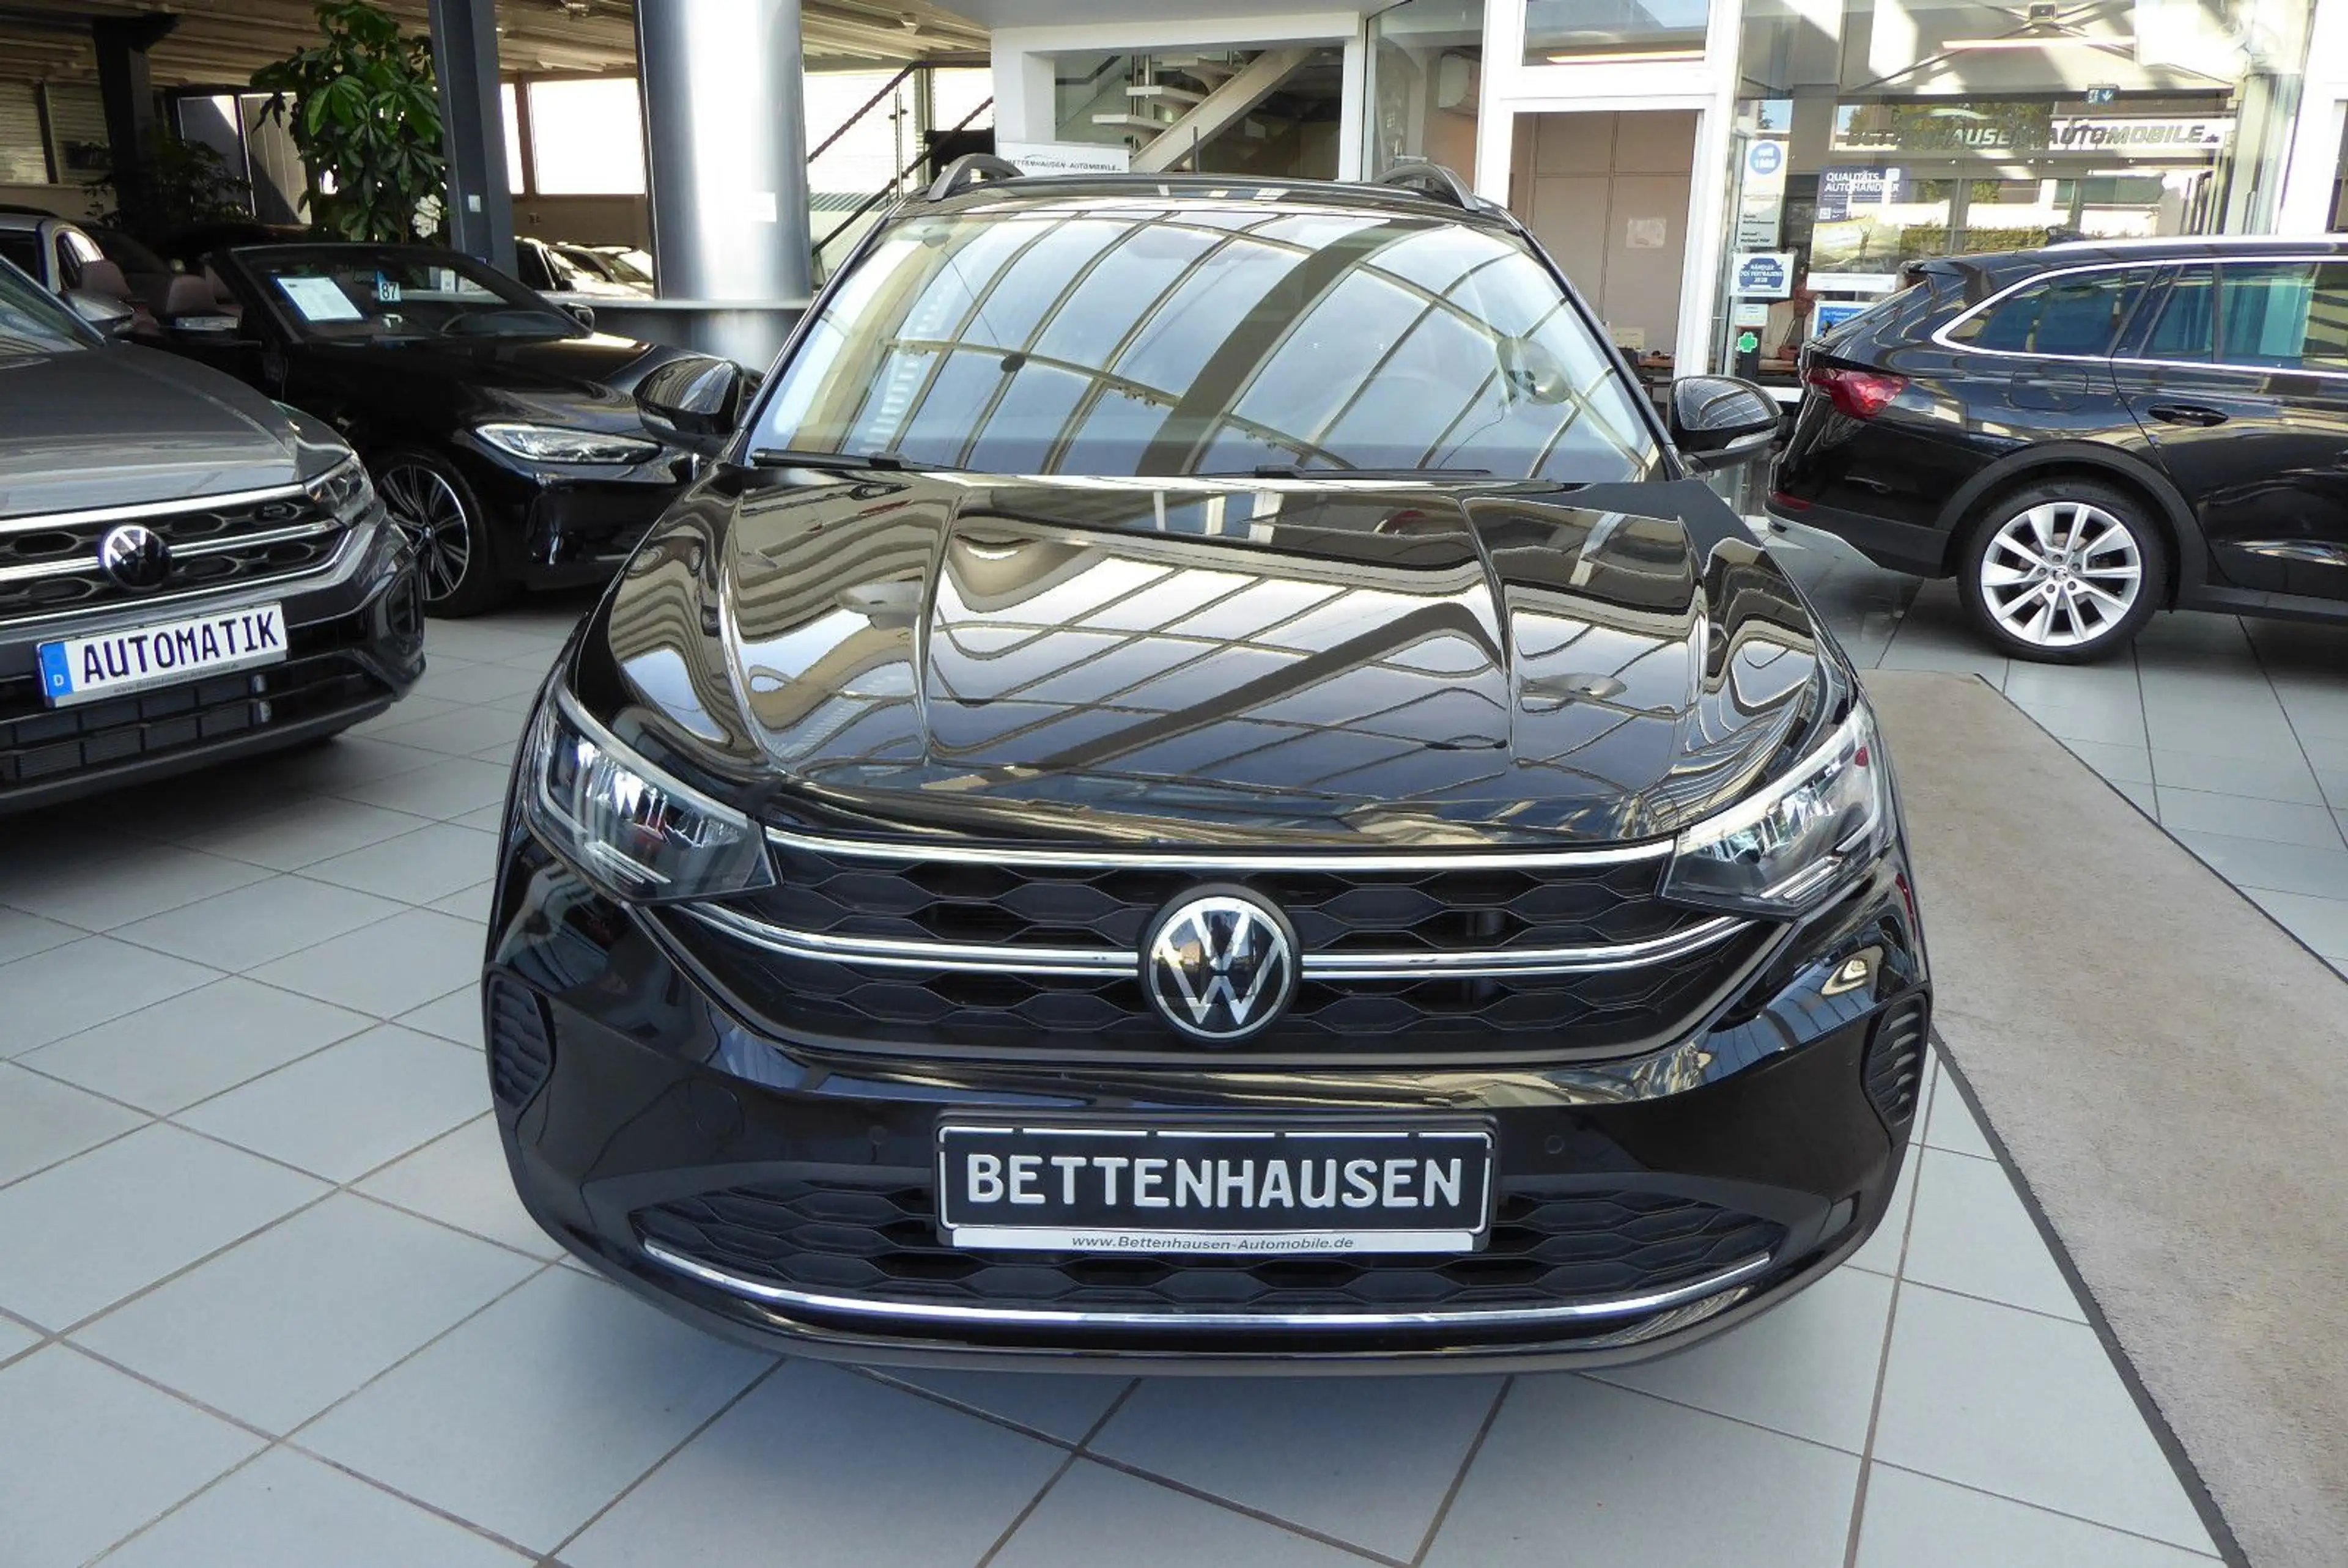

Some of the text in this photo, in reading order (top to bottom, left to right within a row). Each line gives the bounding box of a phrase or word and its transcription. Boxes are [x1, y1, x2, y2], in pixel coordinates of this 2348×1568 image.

[381, 283, 398, 299] 87
[83, 611, 279, 683] AUTOMATIK
[54, 674, 64, 686] D
[966, 1154, 1461, 1208] BETTENHAUSEN
[1071, 1235, 1354, 1251] www.Bettenhausen-Automobile.de
